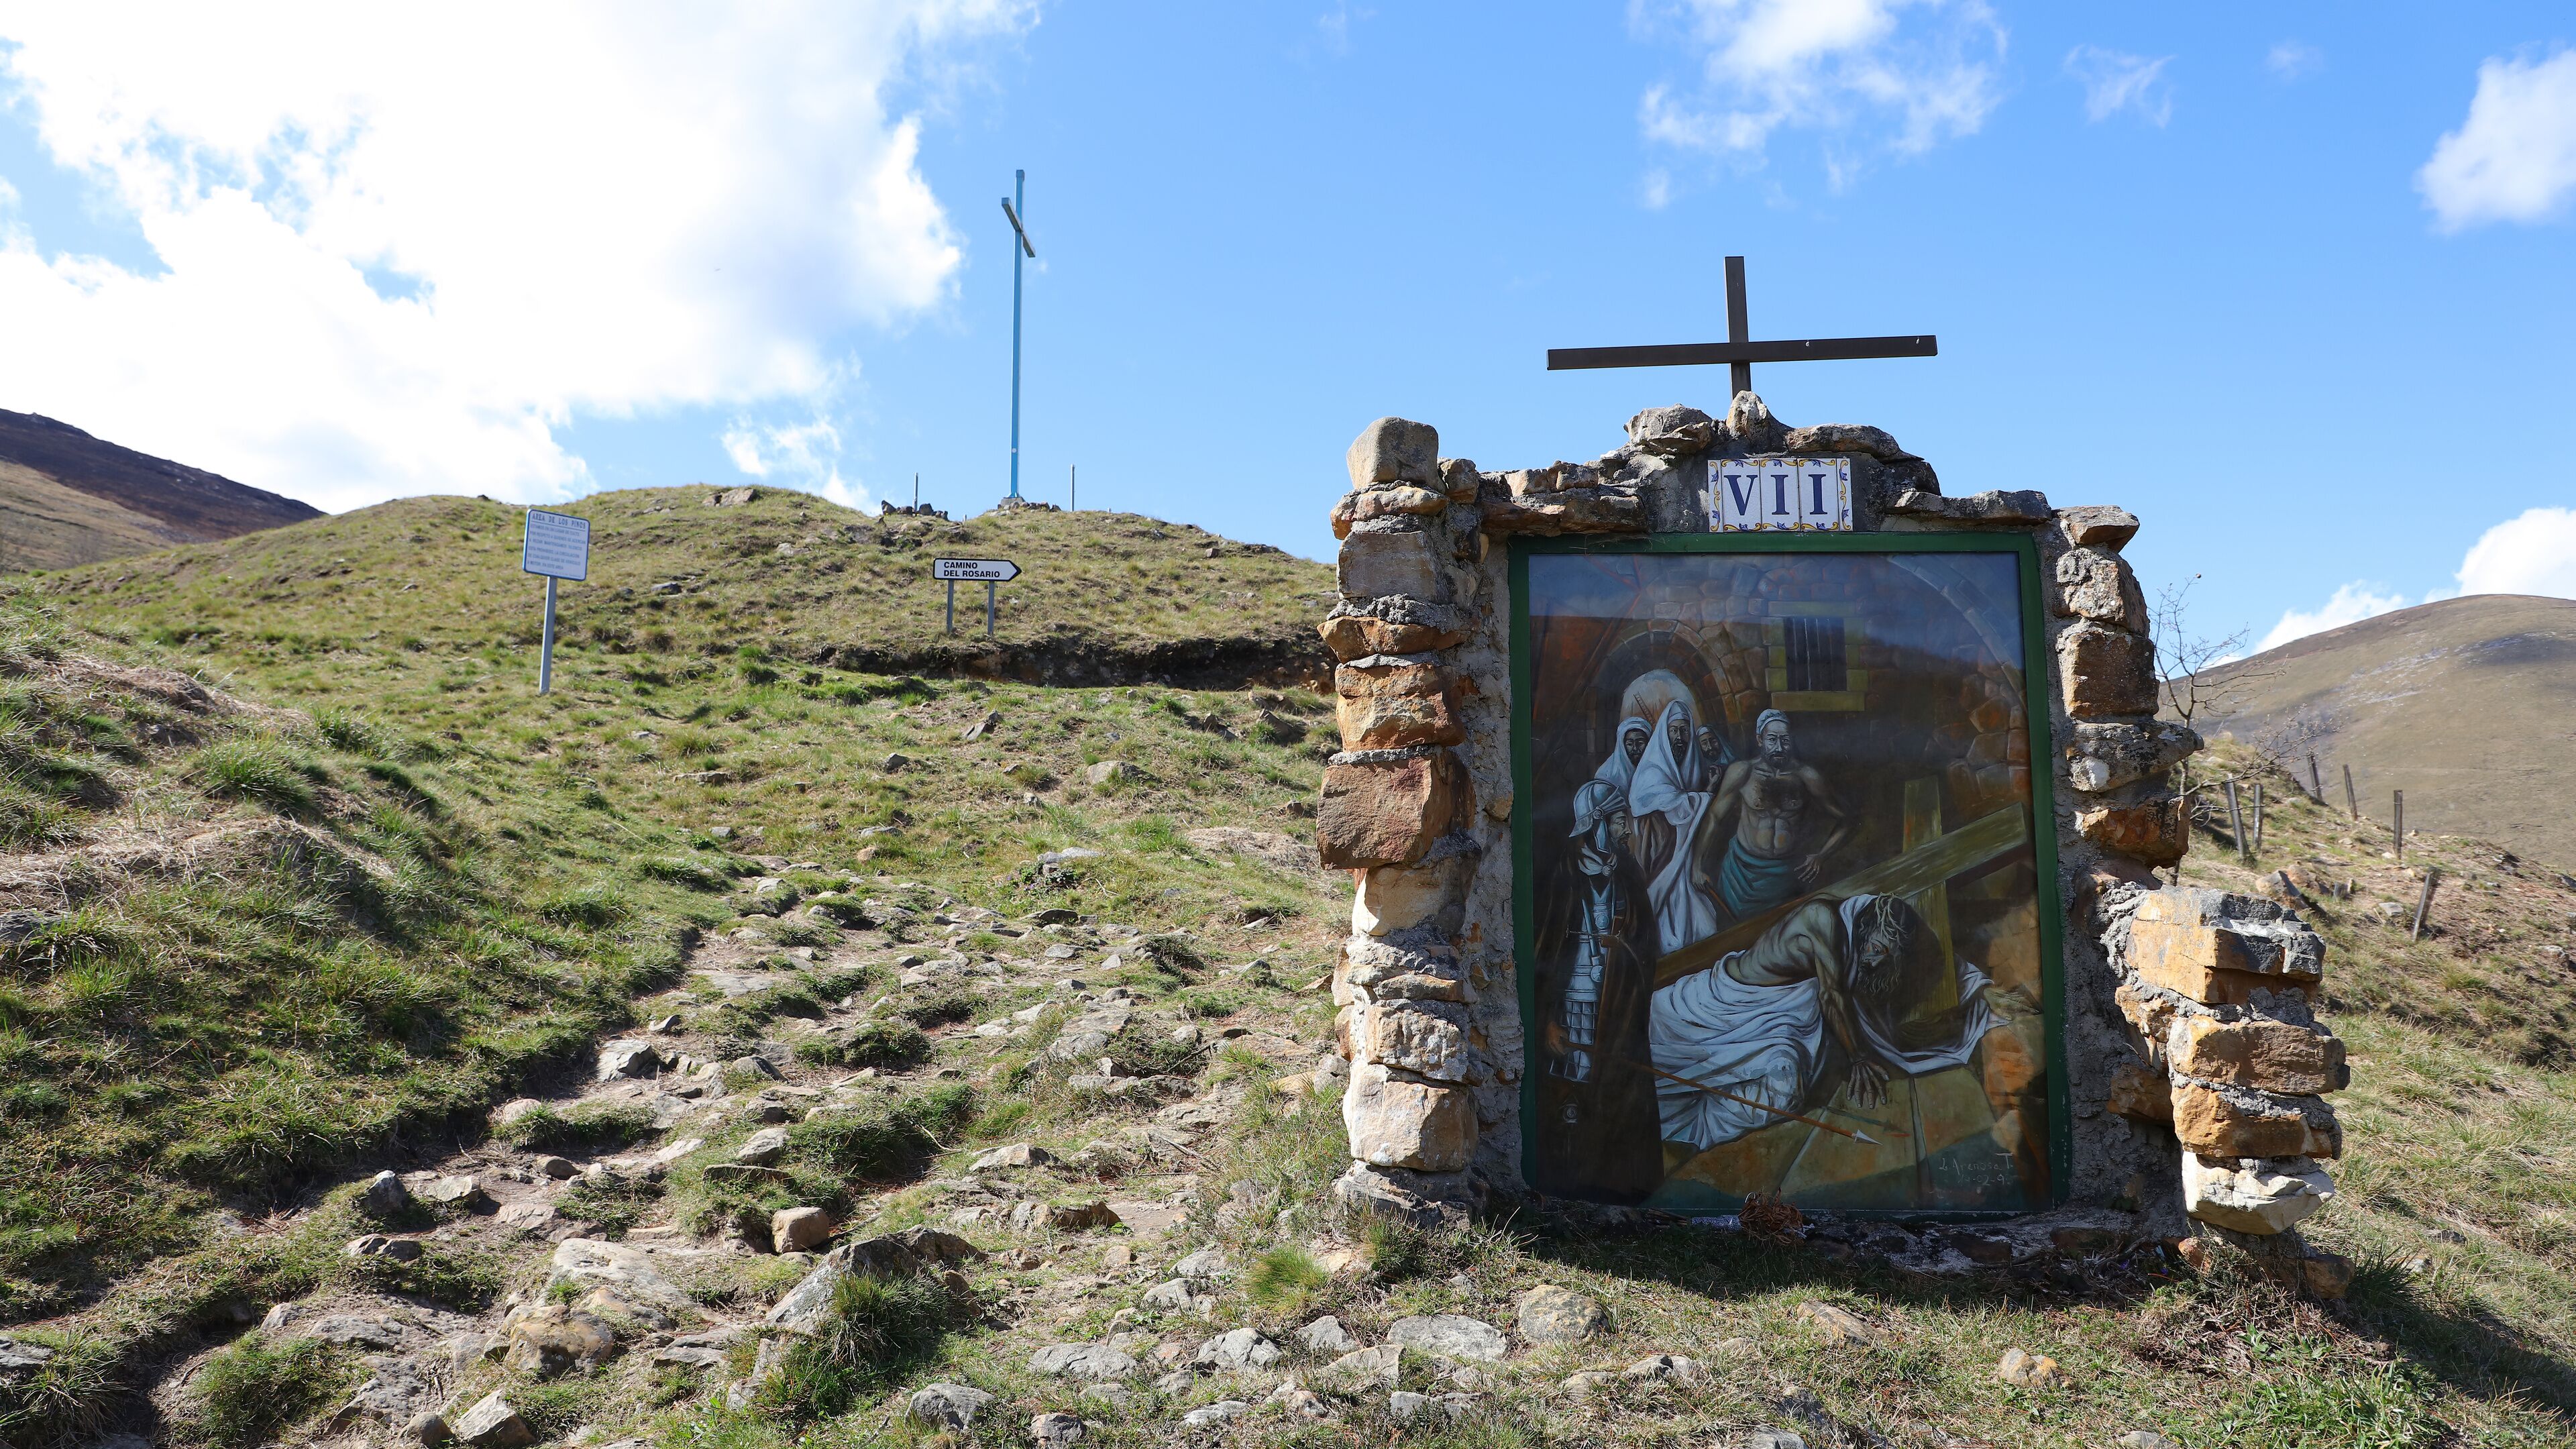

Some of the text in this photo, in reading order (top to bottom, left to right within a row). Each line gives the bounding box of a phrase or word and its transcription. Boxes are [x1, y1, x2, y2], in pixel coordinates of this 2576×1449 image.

[1723, 474, 1828, 516] VII
[549, 516, 555, 524] DE
[558, 517, 568, 525] LOS
[571, 520, 585, 529] PINOS
